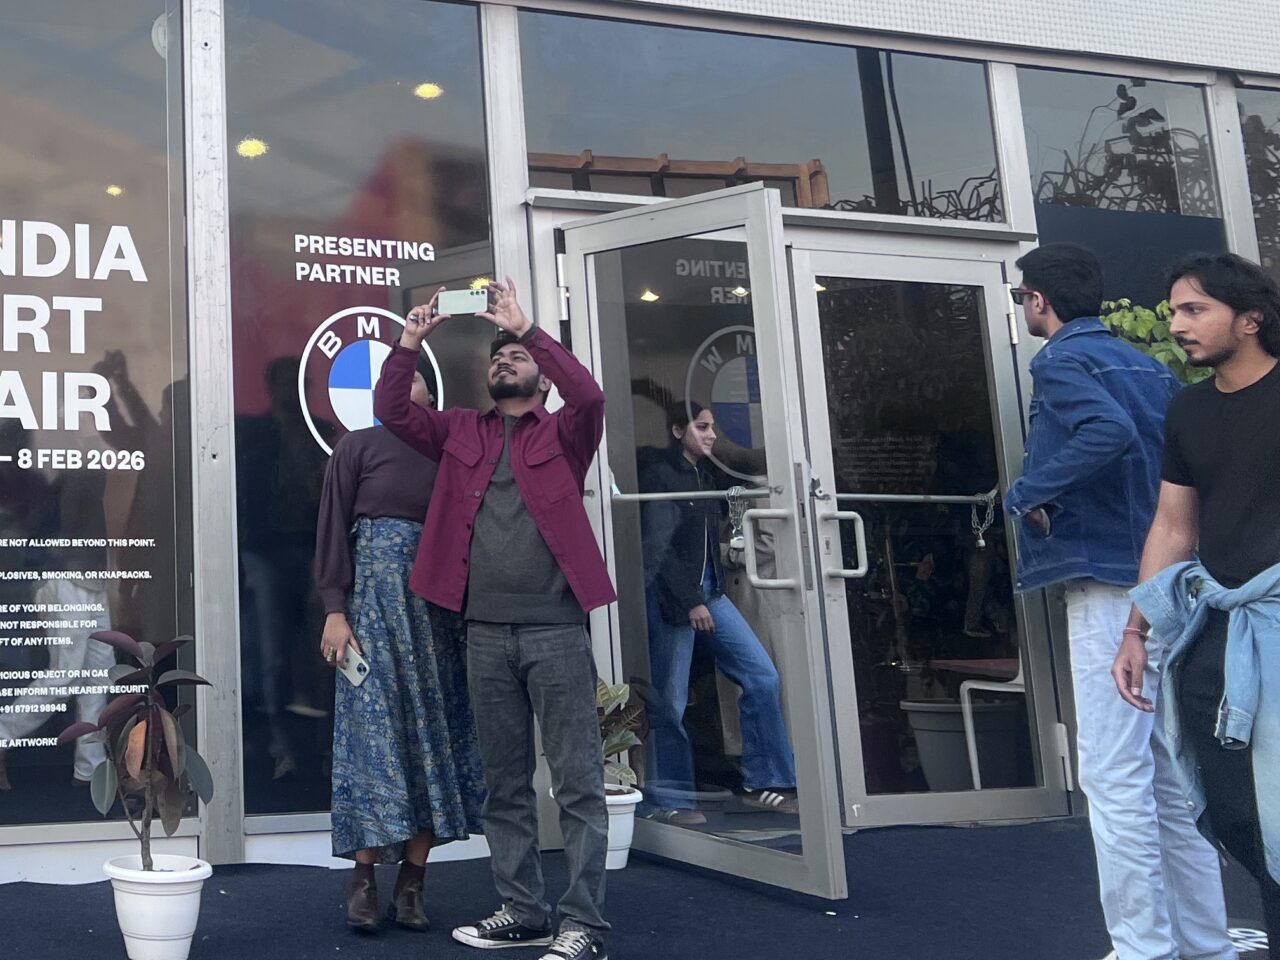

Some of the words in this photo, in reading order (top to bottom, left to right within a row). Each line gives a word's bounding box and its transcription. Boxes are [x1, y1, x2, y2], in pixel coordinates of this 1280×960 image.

[294, 234, 435, 261] PRESENTING
[295, 262, 401, 286] PARTNER
[317, 316, 380, 359] BM
[17, 449, 33, 469] 8
[37, 449, 83, 469] FEB
[87, 450, 145, 470] 2026
[9, 539, 28, 547] NOT
[29, 539, 70, 547] ALLOWED
[72, 539, 106, 547] BEYOND
[108, 539, 128, 547] THIS
[129, 539, 156, 547] POINT.
[42, 572, 84, 580] SMOKING,
[85, 571, 97, 579] OR
[99, 571, 152, 579] KNAPSACKS.
[9, 604, 21, 613] OF
[22, 604, 46, 612] YOUR
[48, 604, 104, 612] BELONGINGS.
[0, 621, 18, 629] NOT
[20, 621, 78, 629] RESPONSIBLE
[80, 620, 97, 628] FOR
[11, 638, 22, 646] OF
[24, 637, 43, 646] ANY
[44, 637, 73, 645] ITEMS.
[32, 671, 66, 679] OBJECT
[68, 670, 80, 678] OR
[82, 670, 90, 678] IN
[91, 669, 108, 677] CAS
[14, 687, 48, 696] INFORM
[49, 687, 67, 695] THE
[69, 686, 108, 695] NEAREST
[110, 685, 149, 694] SECURIT
[40, 704, 66, 712] 98948
